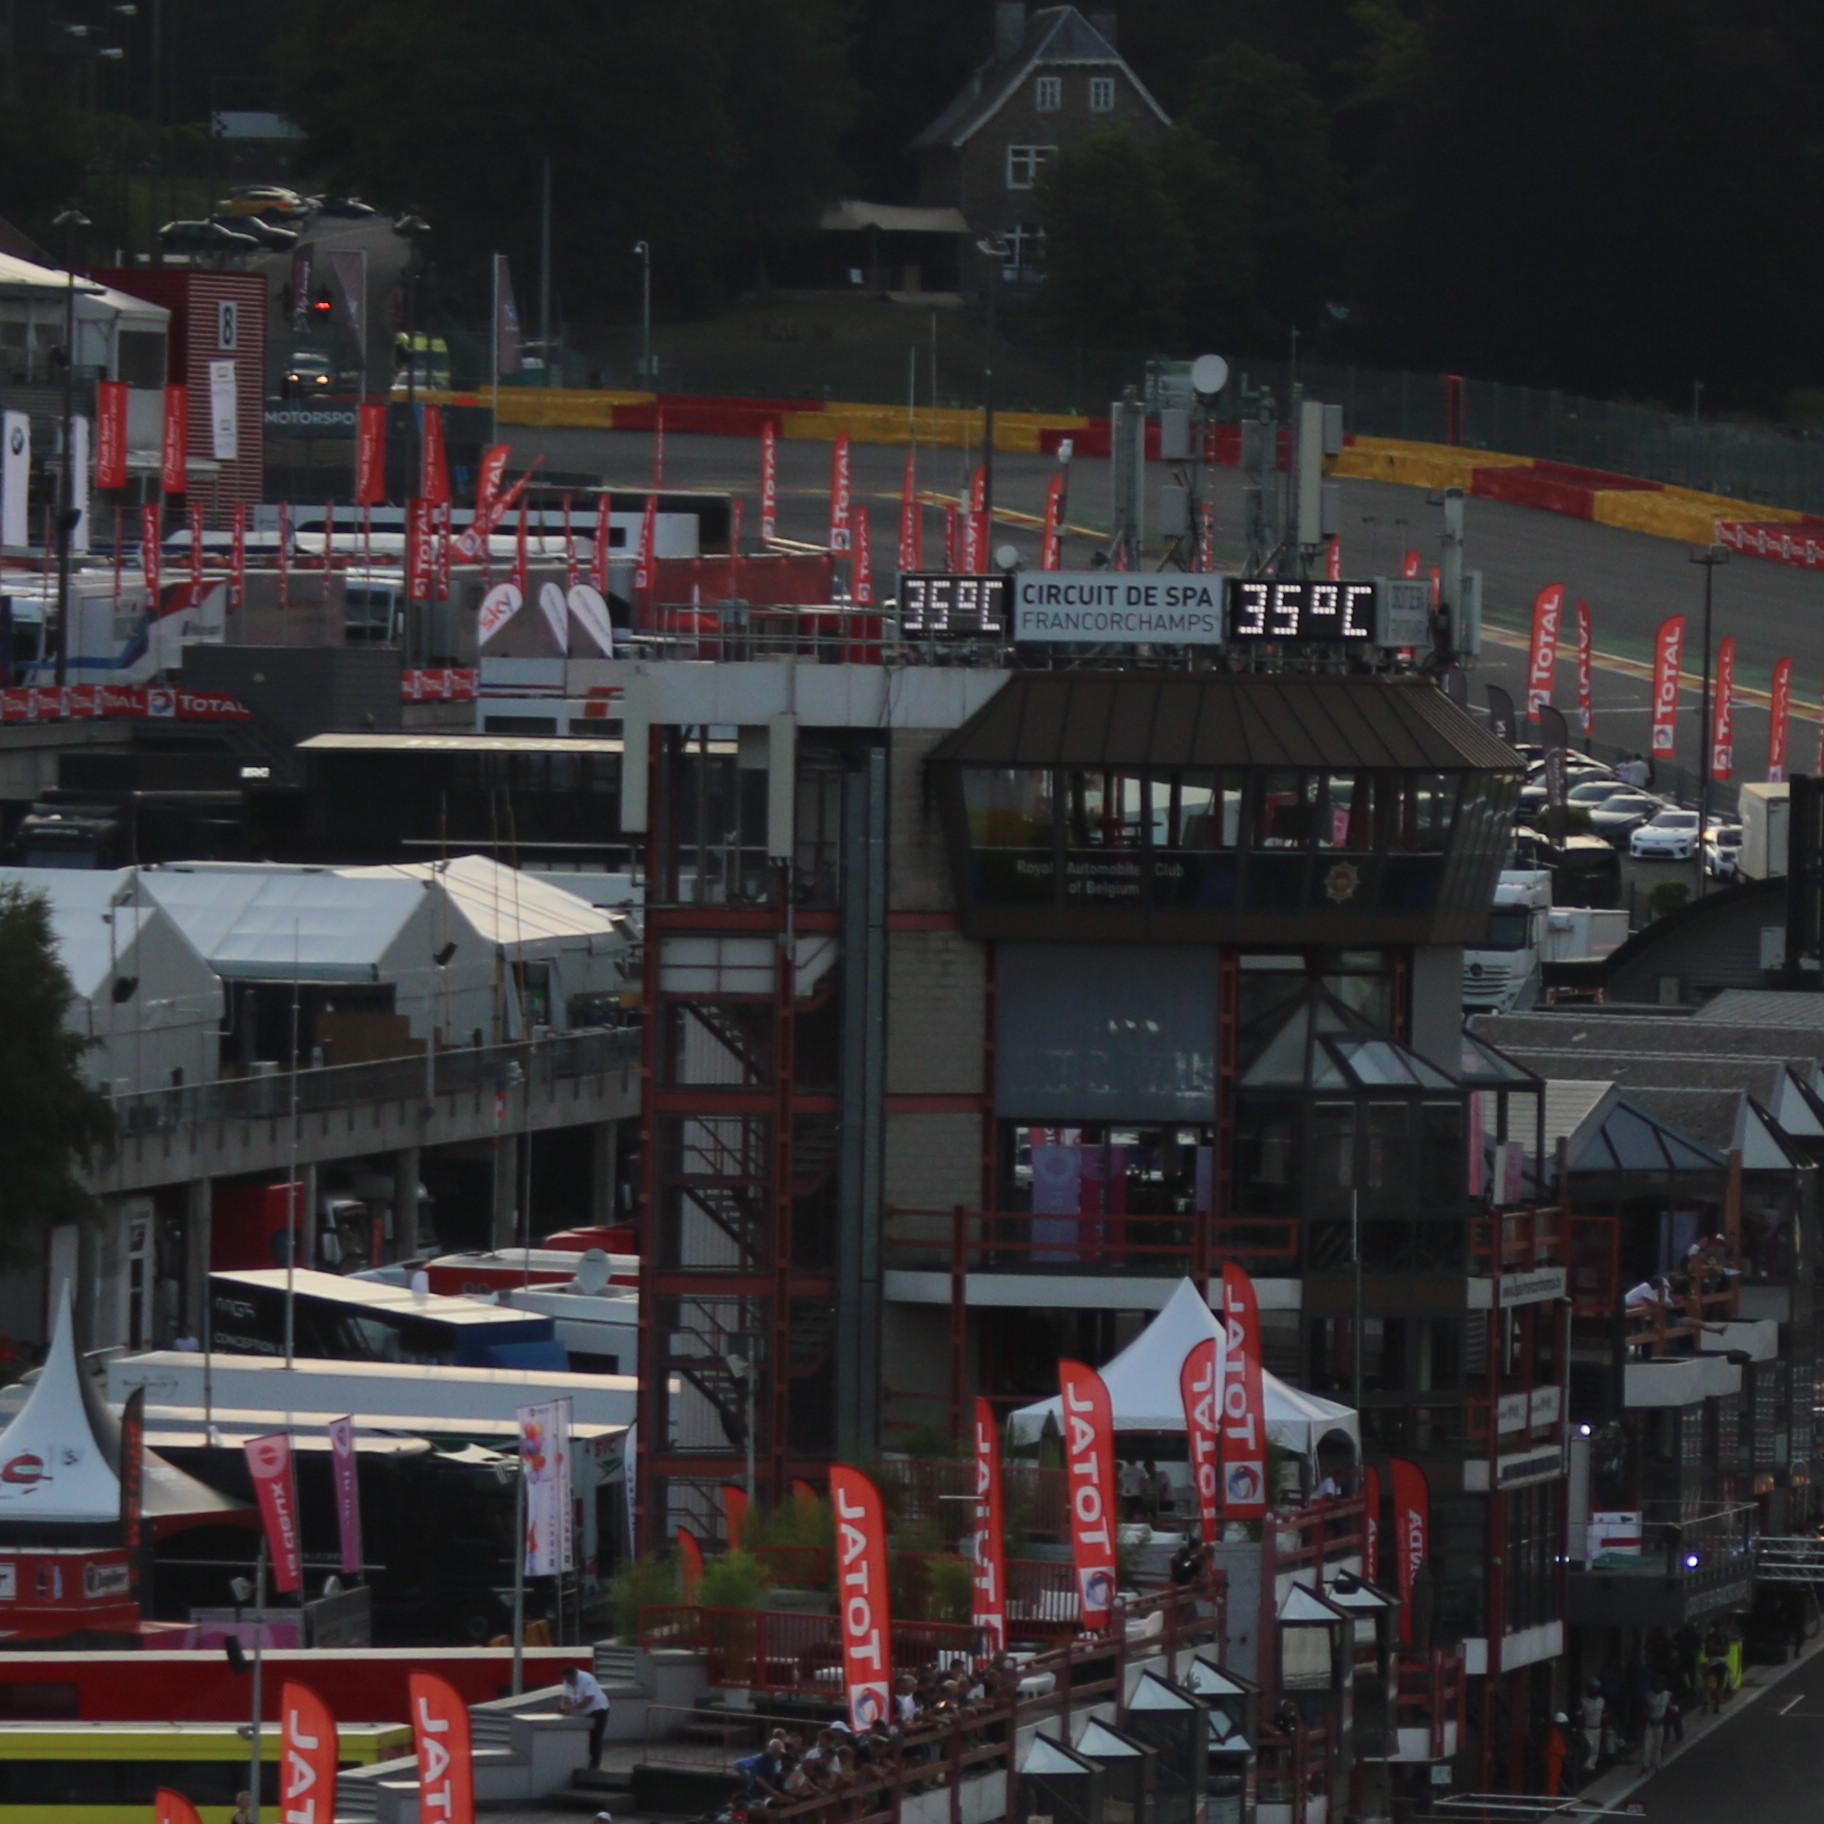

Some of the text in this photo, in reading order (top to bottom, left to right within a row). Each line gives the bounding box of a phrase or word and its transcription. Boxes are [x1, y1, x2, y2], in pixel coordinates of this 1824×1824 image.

[221, 305, 233, 345] 8
[264, 410, 356, 426] MOTORSPO
[764, 439, 775, 506] TOTAL
[833, 445, 849, 522] TOTAL
[1022, 584, 1214, 608] CIRCUIT DE SPA
[1022, 611, 1215, 633] FRANCORCHAMPS
[1531, 593, 1559, 682] TOTAL
[1656, 625, 1680, 720] TOTAL
[180, 694, 251, 714] TOTAL
[1155, 860, 1185, 877] Club
[1068, 879, 1141, 898] of Belgium
